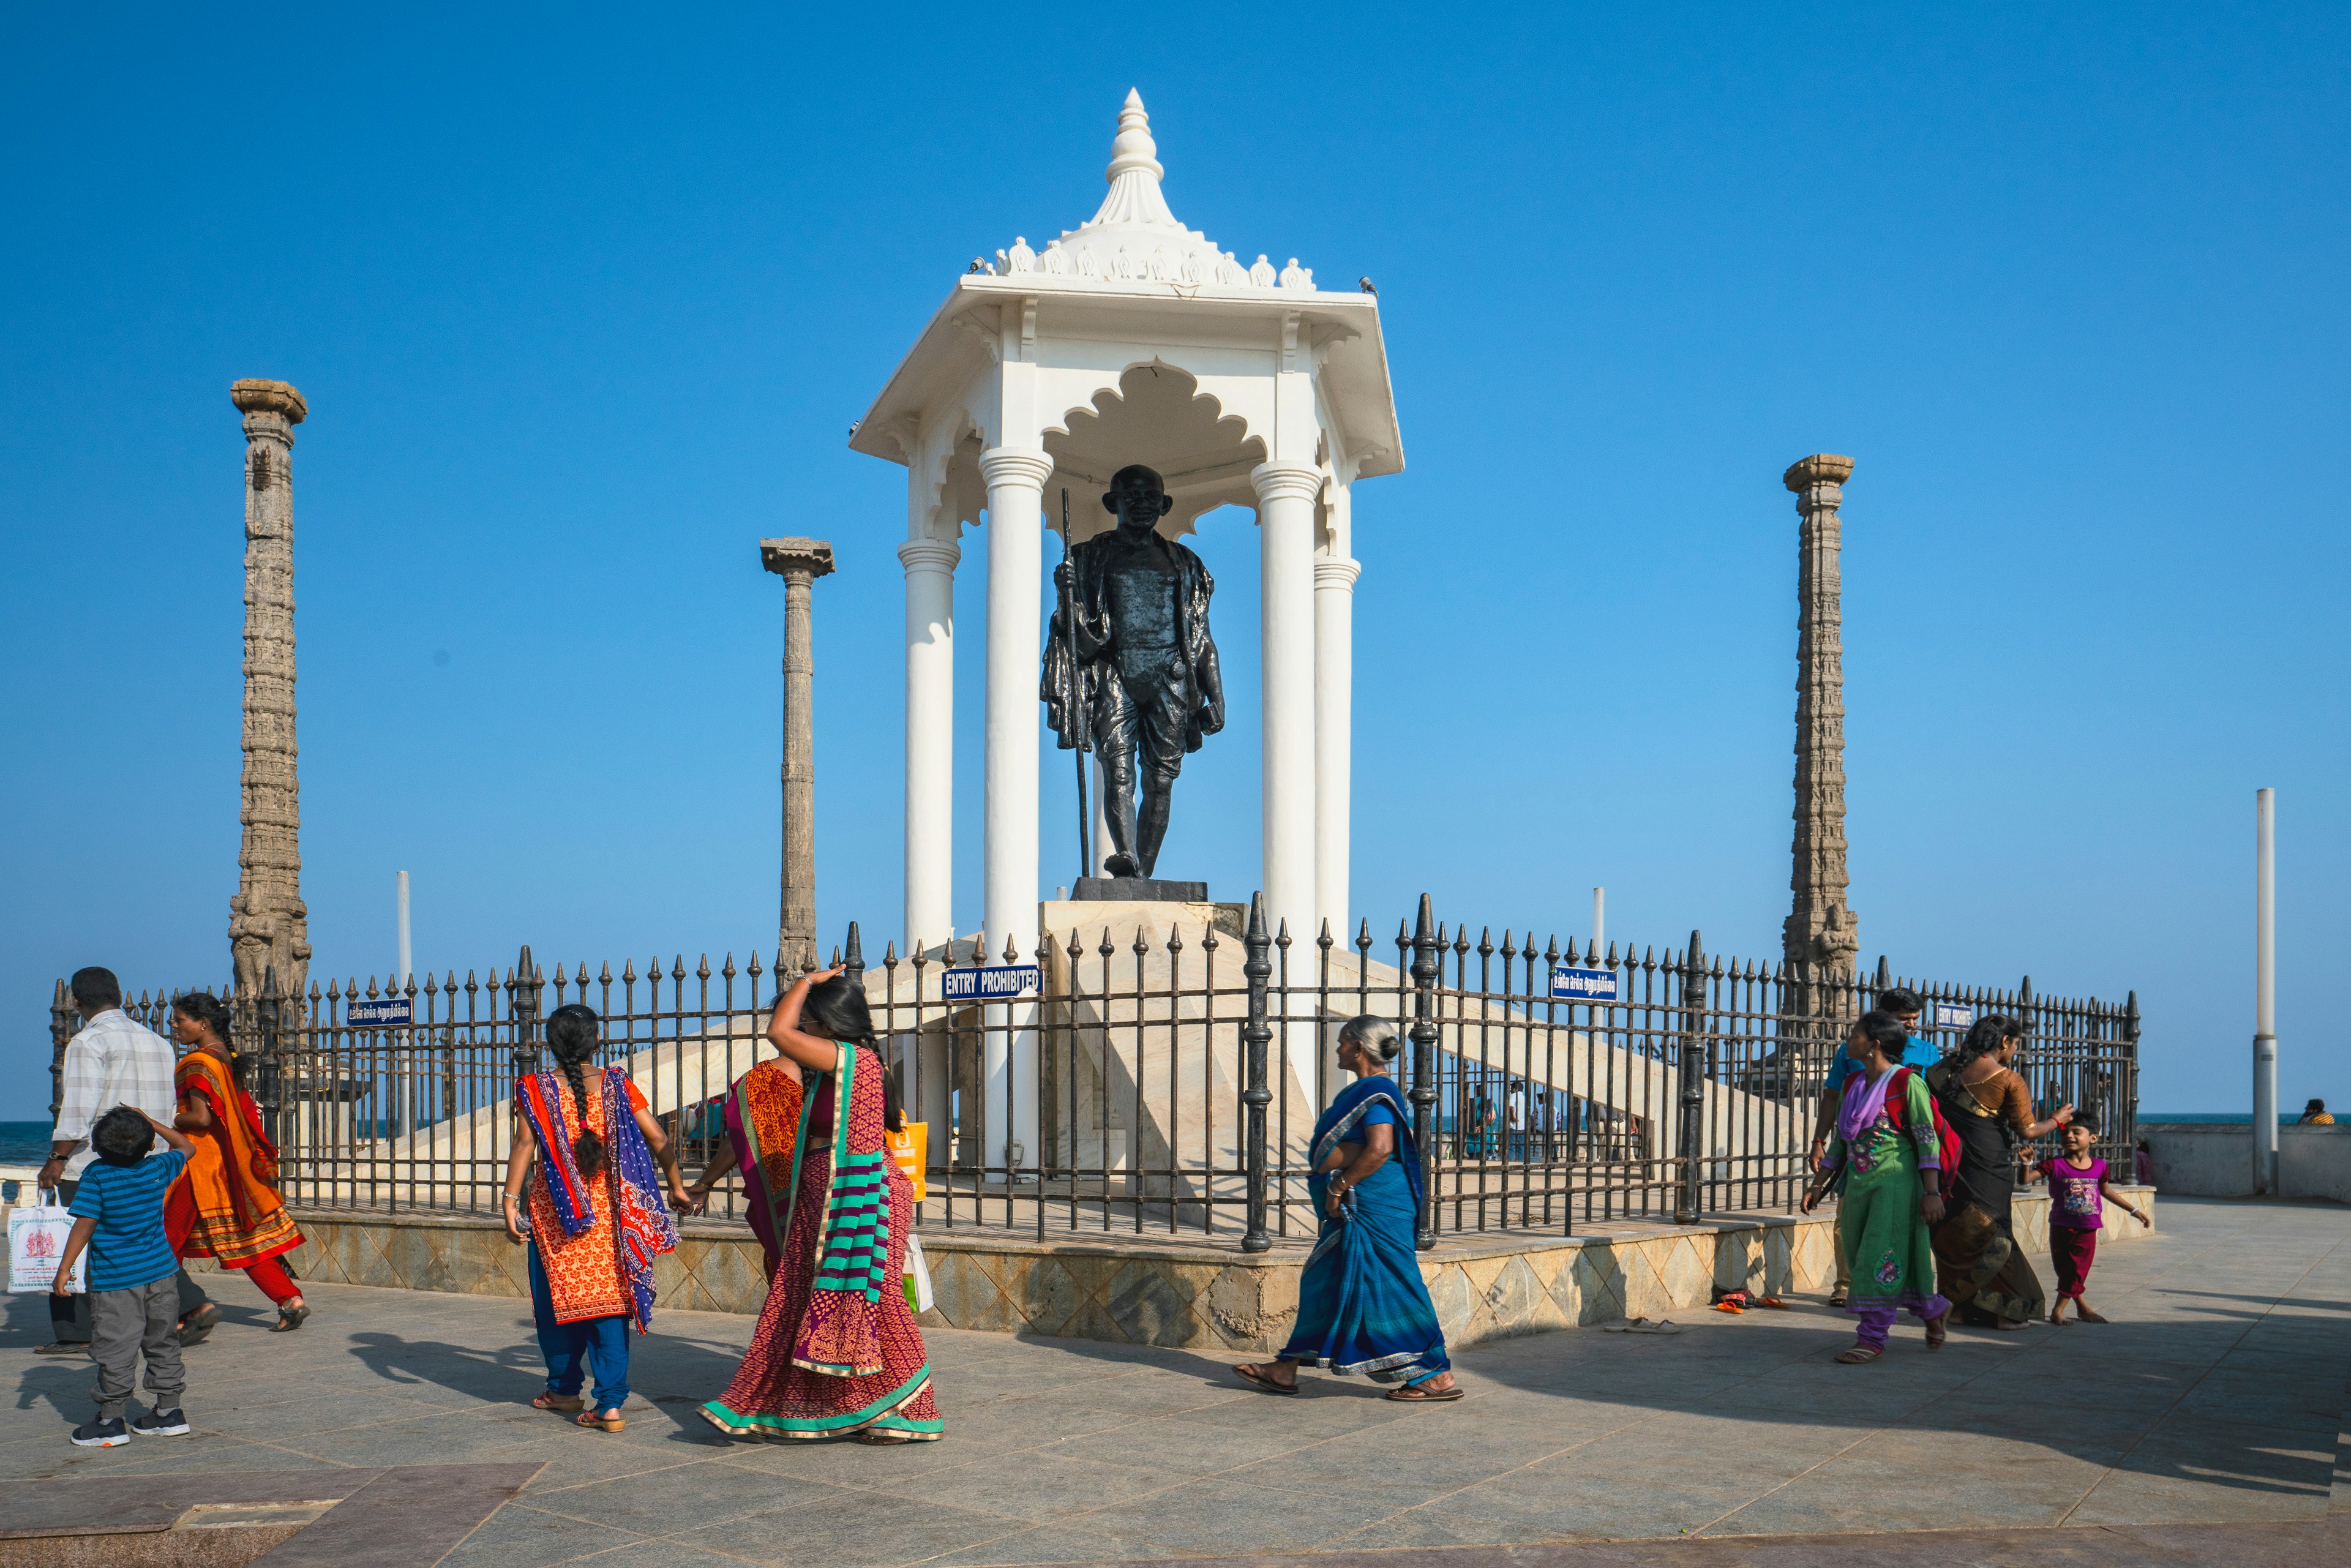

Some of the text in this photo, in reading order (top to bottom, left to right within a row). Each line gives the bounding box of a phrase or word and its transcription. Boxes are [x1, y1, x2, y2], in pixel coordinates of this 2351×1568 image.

[946, 969, 1039, 994] ENTRY PROHIBITED
[1570, 972, 1583, 991] செல்ல
[363, 1004, 377, 1019] செல்ல
[1939, 1007, 1952, 1024] ENTRY
